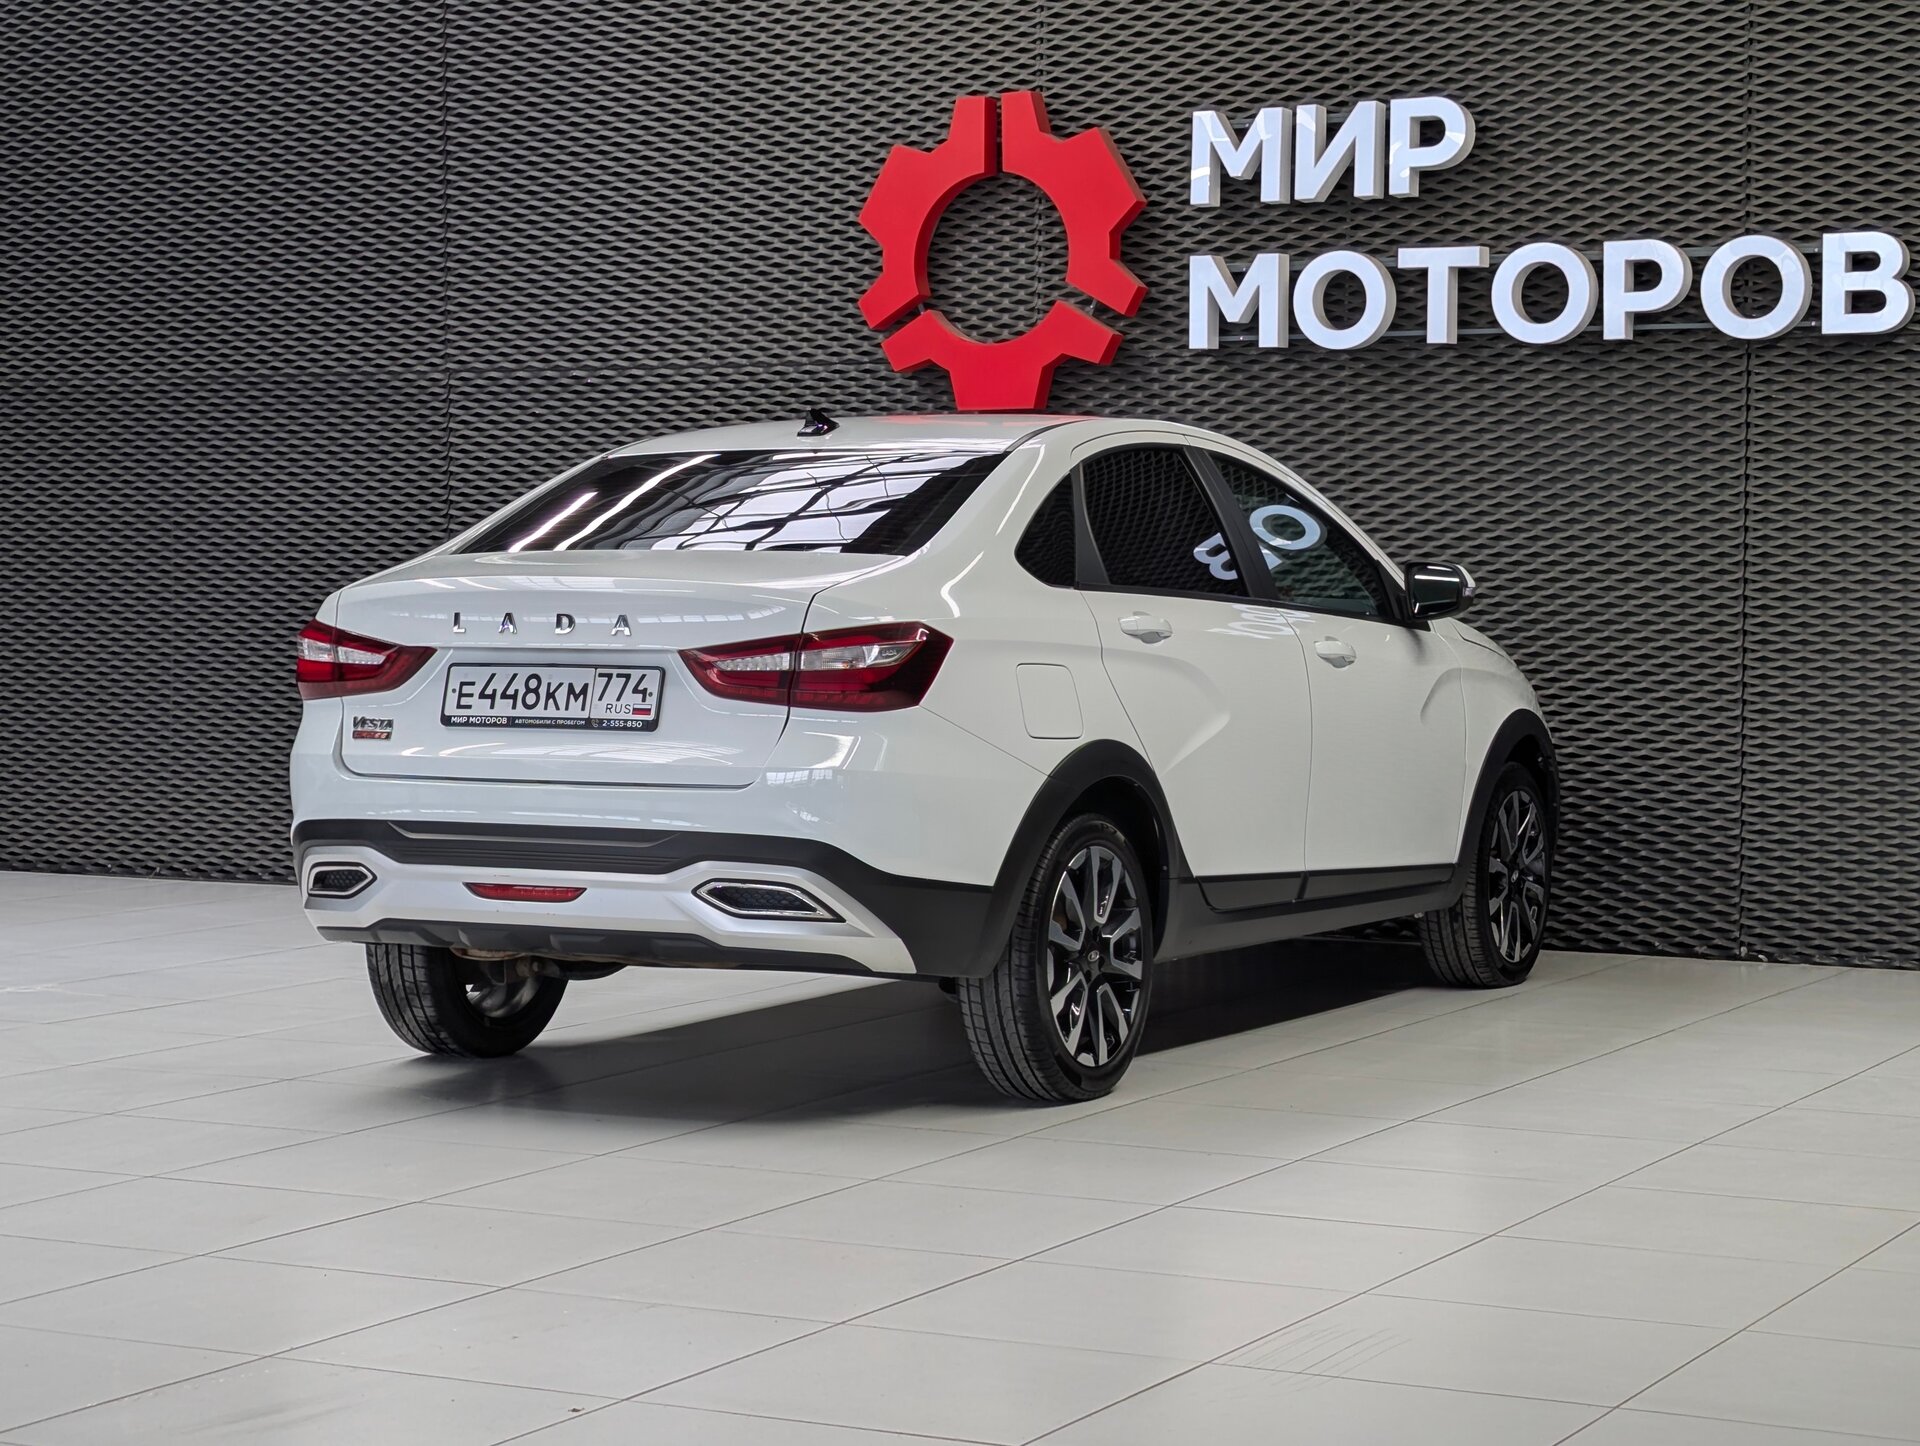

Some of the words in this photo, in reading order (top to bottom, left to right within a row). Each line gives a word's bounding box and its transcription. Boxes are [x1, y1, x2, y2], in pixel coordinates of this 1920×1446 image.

[1189, 95, 1475, 207] МИР
[1188, 231, 1915, 350] МОТОРОВ
[453, 611, 632, 637] LADA
[455, 672, 589, 712] Е448КМ
[597, 672, 648, 703] 774
[450, 716, 468, 724] МИР
[469, 716, 508, 725] МОТОРОВ
[602, 719, 643, 728] 2-555-850
[604, 703, 631, 715] RUS
